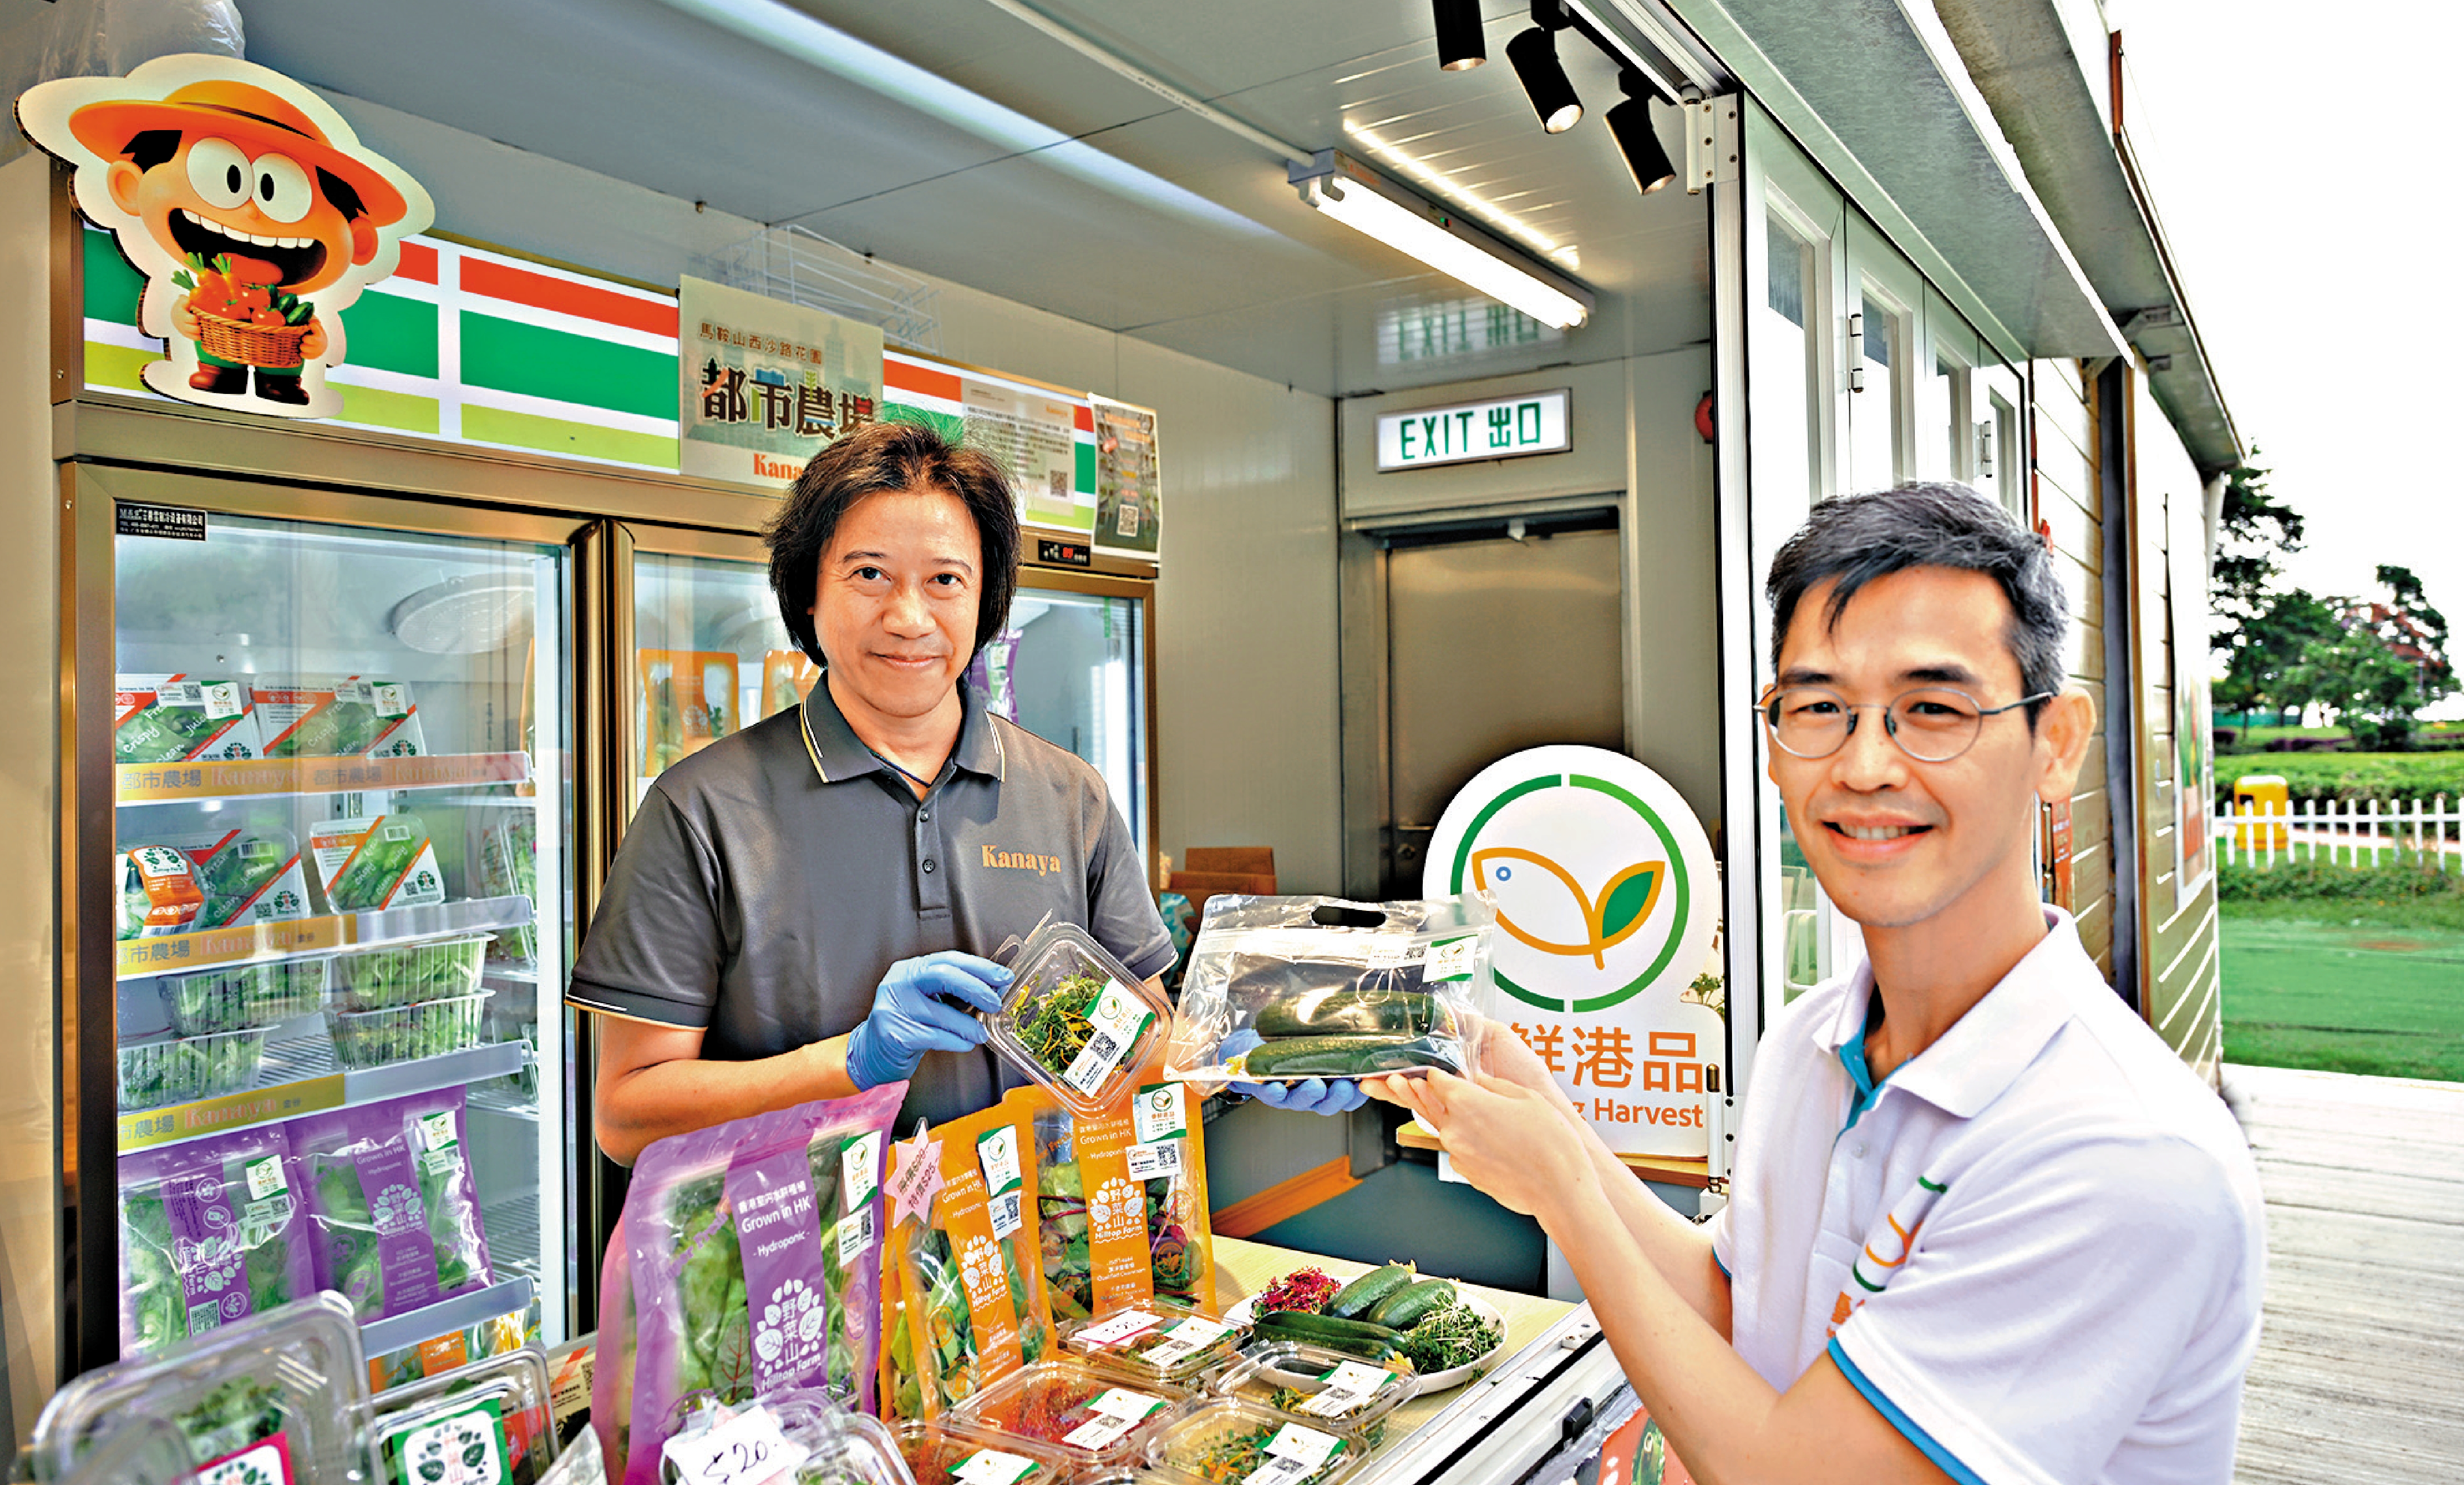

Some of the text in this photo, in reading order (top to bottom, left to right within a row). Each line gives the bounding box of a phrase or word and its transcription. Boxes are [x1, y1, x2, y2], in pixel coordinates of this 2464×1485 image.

[702, 357, 875, 440] 都市農場
[1400, 410, 1474, 460] EXIT
[1488, 402, 1541, 448] 出口
[754, 453, 803, 480] Kana
[123, 726, 160, 753] Crispy
[122, 769, 202, 790] 都市農場
[982, 844, 1062, 877] Kanaya
[185, 1099, 277, 1129] Kanaya
[1594, 1098, 1703, 1128] Harvest
[1080, 1134, 1108, 1144] Grown
[1118, 1128, 1131, 1138] HK
[942, 1187, 966, 1203] Grown
[972, 1179, 984, 1192] HK
[741, 1194, 812, 1233] Grown in HK
[757, 1230, 806, 1258] Hydroponic
[797, 1353, 822, 1372] Farm
